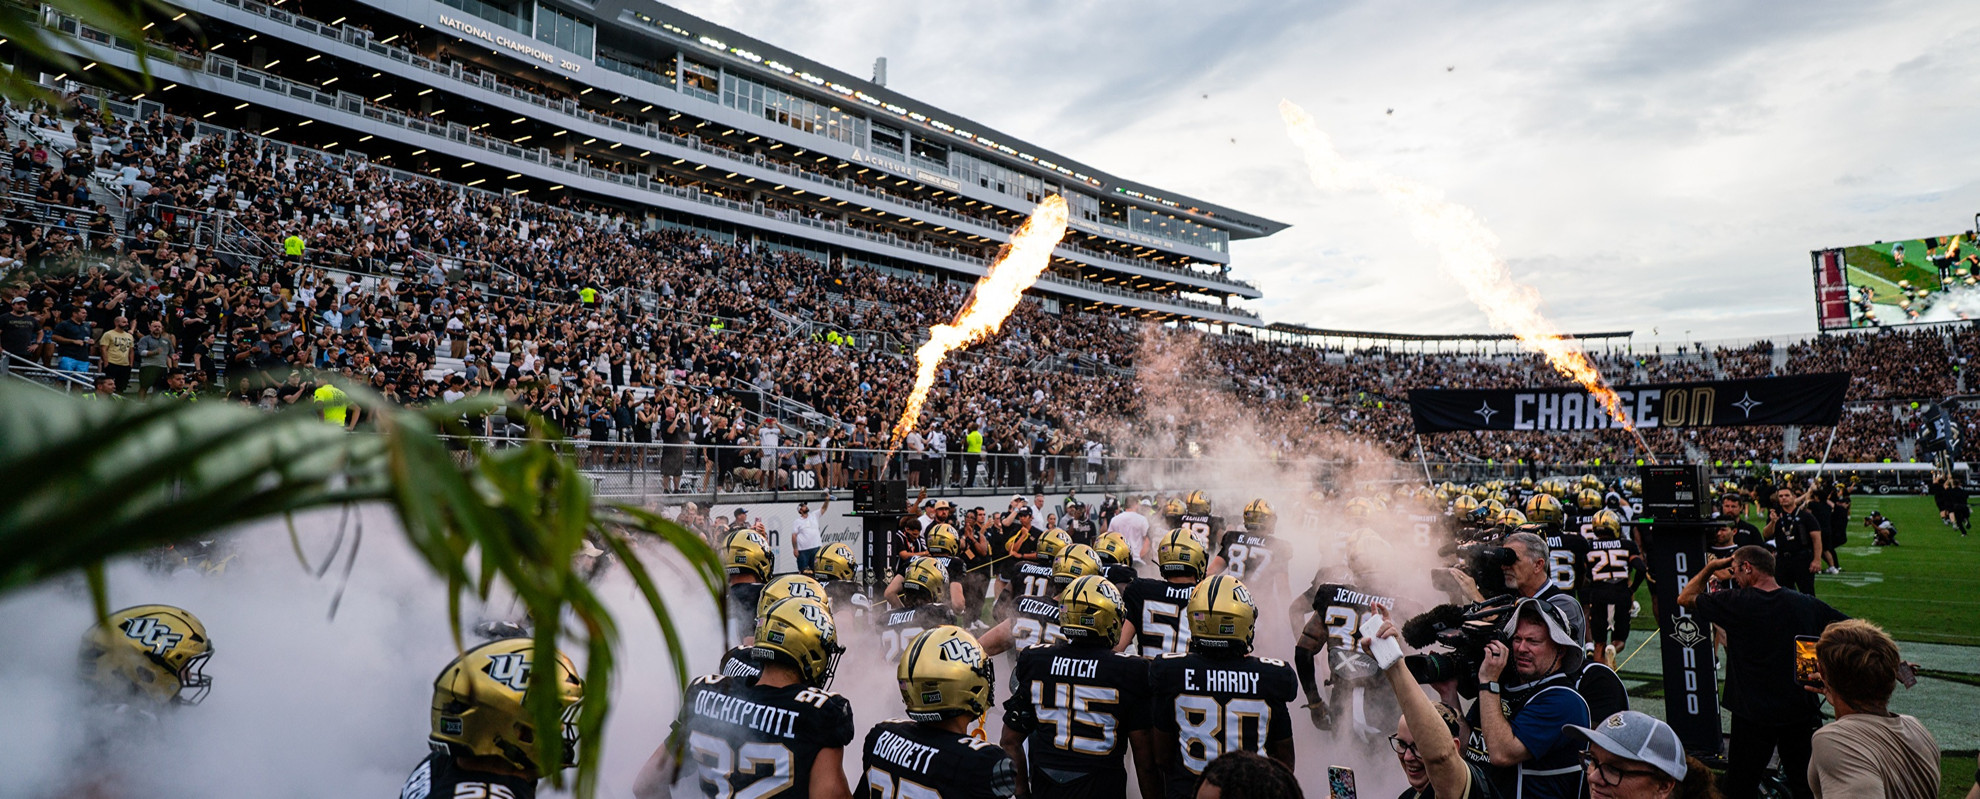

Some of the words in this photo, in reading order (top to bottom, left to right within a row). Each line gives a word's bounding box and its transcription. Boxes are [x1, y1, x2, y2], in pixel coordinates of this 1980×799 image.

[440, 14, 495, 43] NATIONAL
[496, 36, 554, 63] CHAMPIONS
[560, 59, 581, 73] 2017
[865, 155, 912, 176] ACRISURE
[792, 470, 816, 489] 106
[1086, 471, 1098, 485] 107
[1238, 534, 1245, 544] B.
[1246, 535, 1266, 546] HALL
[1593, 540, 1622, 550] STROUD
[1228, 543, 1274, 582] 87
[1586, 549, 1631, 581] 25
[1022, 575, 1048, 597] 11
[1333, 587, 1396, 611] JENNINGS
[799, 603, 836, 643] UCF
[887, 610, 916, 627] IRVIN
[124, 617, 184, 658] UCF
[938, 637, 984, 669] UCF
[486, 652, 535, 706] UC
[1050, 656, 1099, 679] HATCH
[1184, 668, 1201, 692] E.
[1206, 669, 1260, 695] HARDY
[694, 688, 800, 739] OCCHIPINTI
[1030, 679, 1120, 757] 45
[1174, 693, 1273, 776] 80
[688, 729, 796, 799] 32
[872, 730, 940, 775] BURNETT
